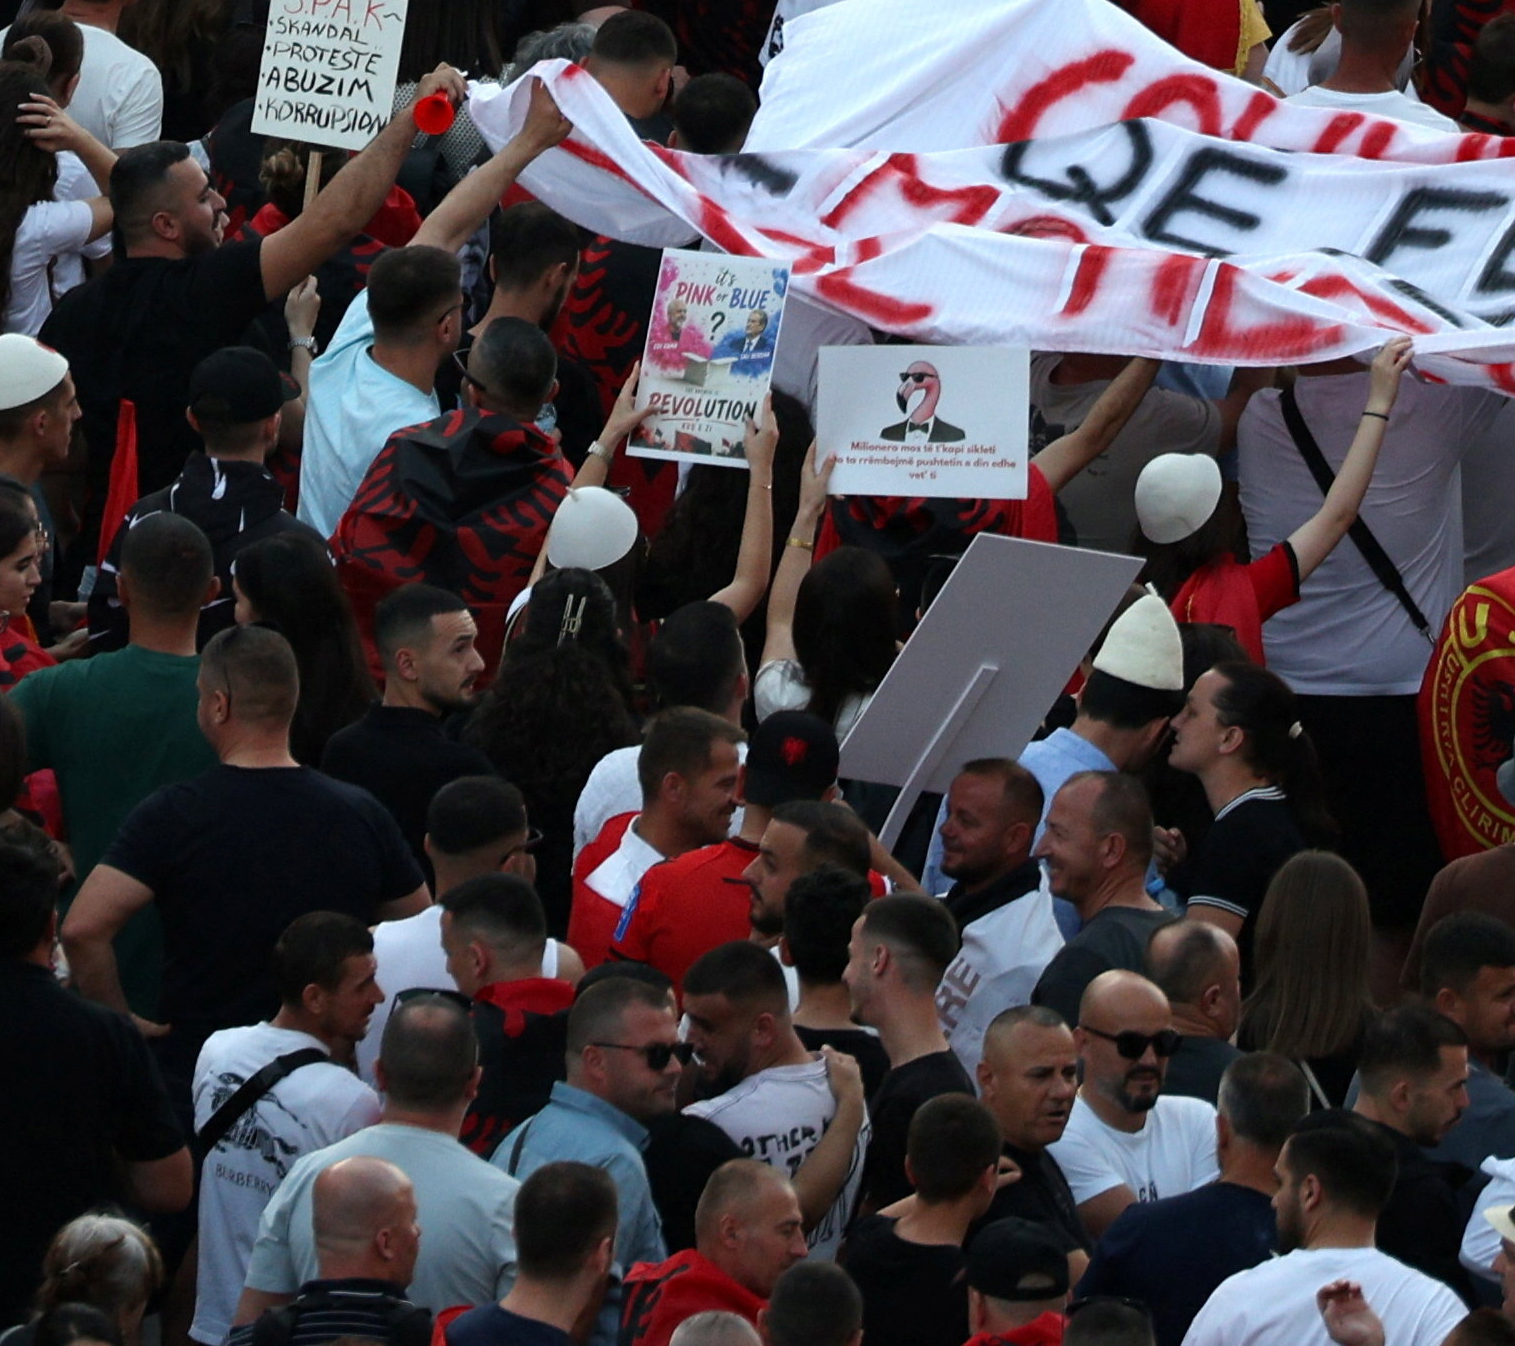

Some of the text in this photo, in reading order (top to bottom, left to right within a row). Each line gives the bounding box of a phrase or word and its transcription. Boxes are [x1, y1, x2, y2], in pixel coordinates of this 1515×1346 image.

[275, 16, 369, 46] SKANDAL
[273, 42, 382, 76] PROTESTË
[265, 67, 374, 103] ABUZIM
[1002, 119, 1289, 257] QE
[715, 266, 737, 287] it's
[675, 282, 771, 311] PINK or BLUE
[648, 392, 758, 423] REVOLUTION
[900, 443, 921, 453] mos
[966, 444, 997, 455] sikleti
[916, 458, 962, 469] pushtetin
[991, 459, 1017, 469] edhe
[215, 1163, 275, 1197] BURBERRY
